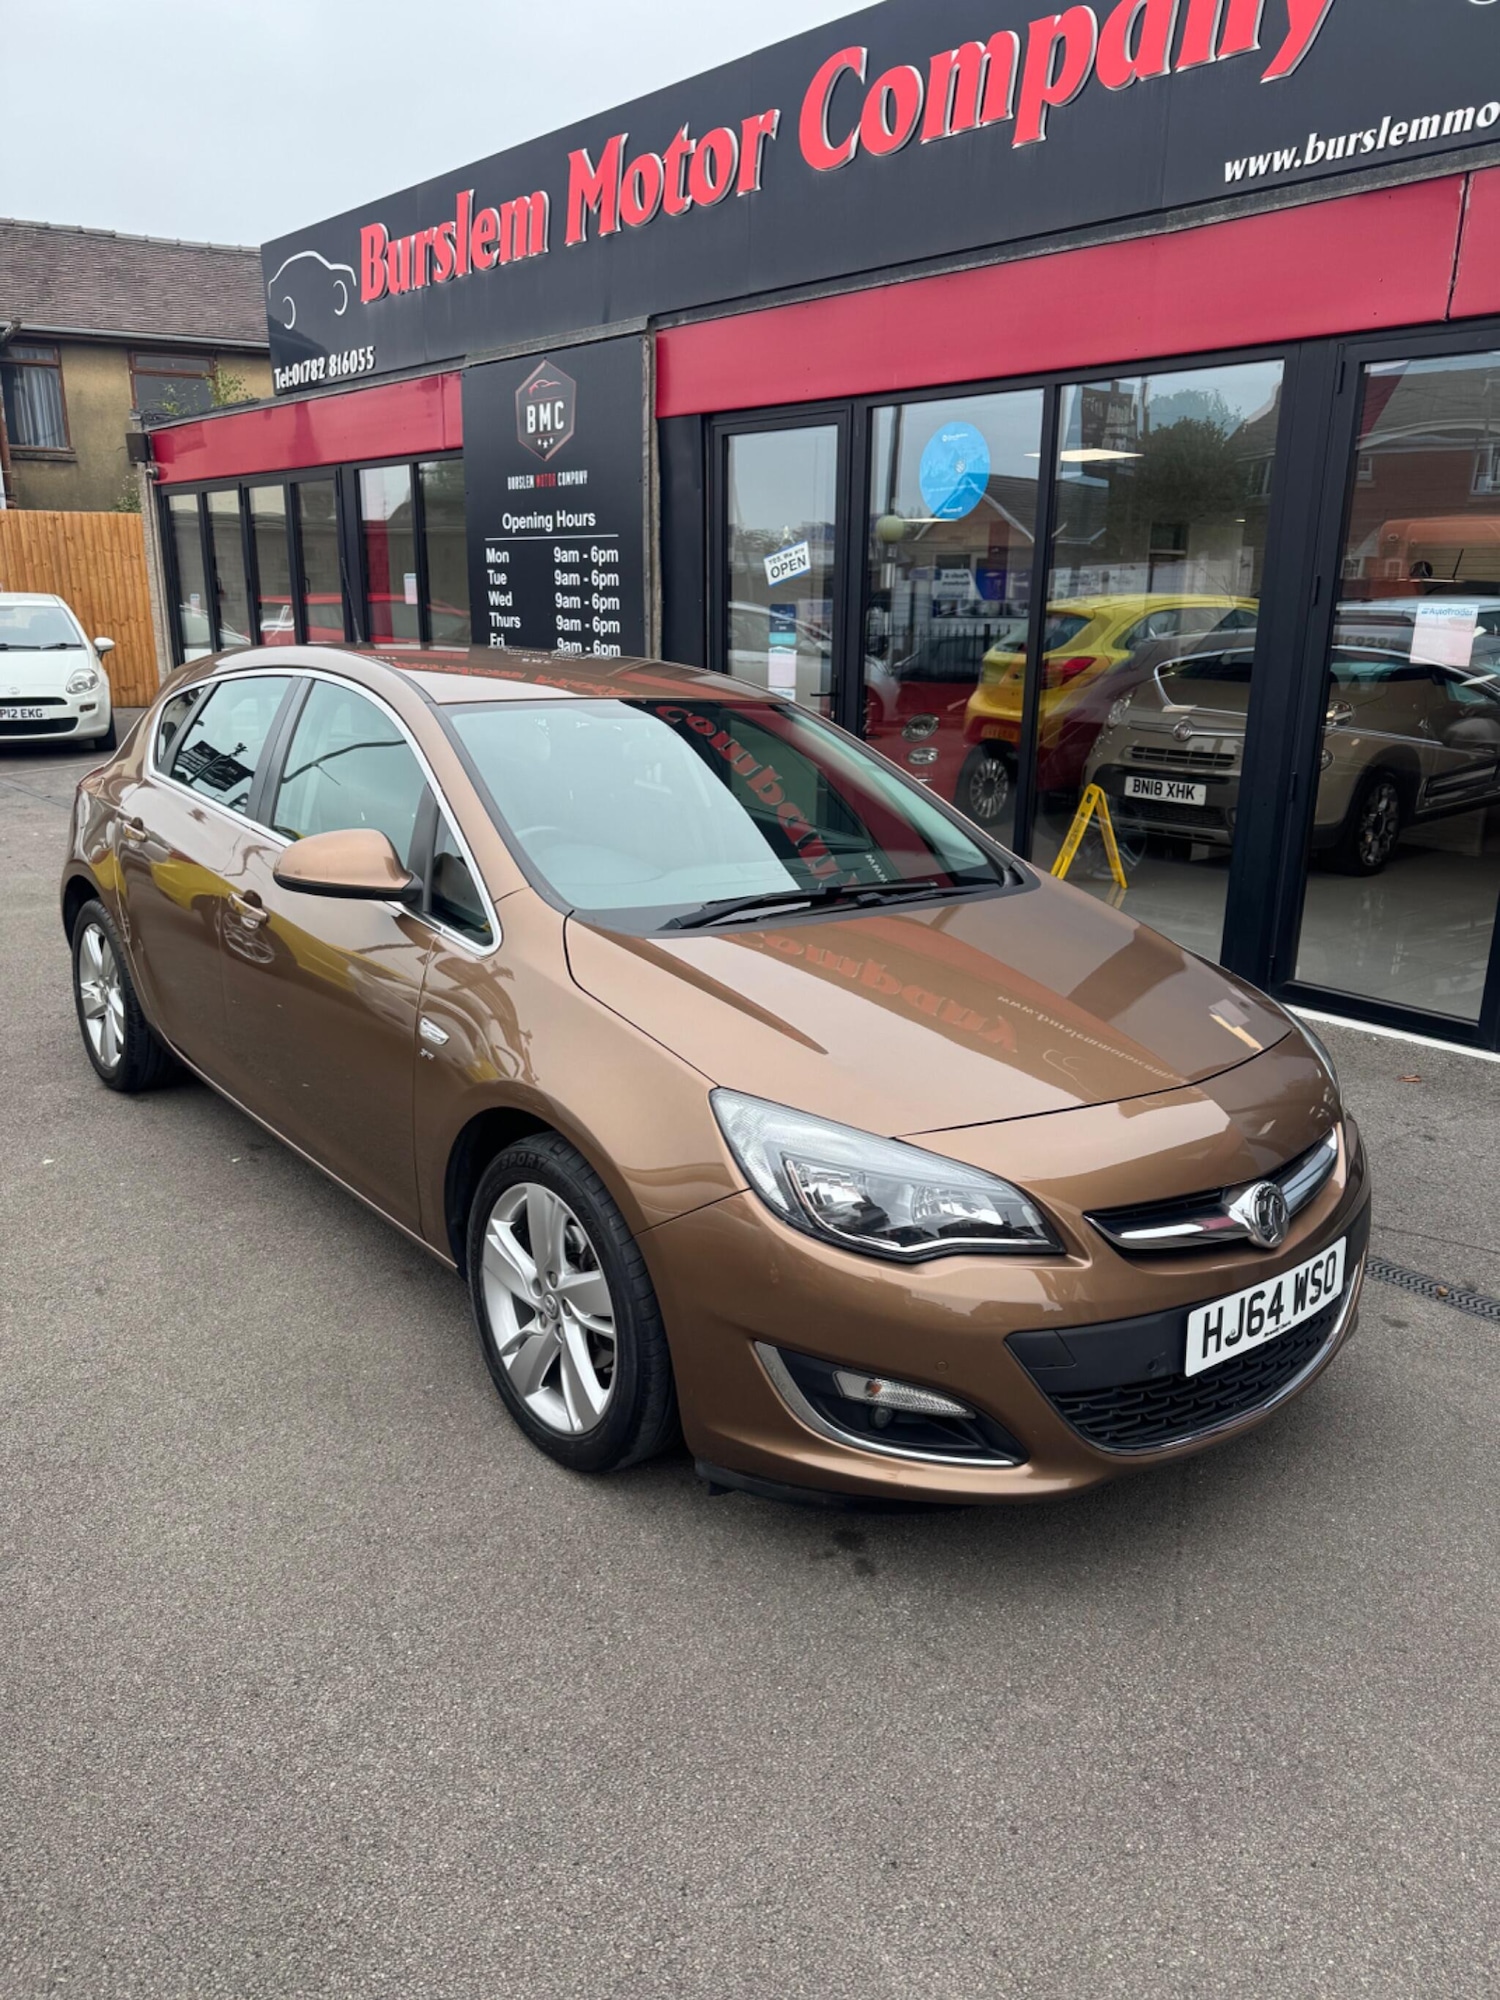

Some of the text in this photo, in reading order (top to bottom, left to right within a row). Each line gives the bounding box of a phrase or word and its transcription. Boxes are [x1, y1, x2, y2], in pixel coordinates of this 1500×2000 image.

[360, 0, 1335, 304] Burslem Motor Company
[1224, 101, 1500, 184] www.burslemmo
[274, 345, 375, 390] Tel:01782 816055
[526, 401, 565, 434] BMC
[557, 470, 588, 487] COMPANY
[502, 510, 596, 533] Opening Hours
[486, 548, 509, 563] Mon
[554, 546, 579, 563] 9am
[590, 545, 619, 566] 6pm
[770, 554, 806, 578] OPEN
[487, 569, 507, 585] Tue
[554, 569, 580, 586] 9am
[591, 569, 620, 590] 6pm
[488, 591, 513, 606] Wed
[555, 592, 581, 608] 9am
[591, 593, 620, 613] 6pm
[489, 612, 521, 628] Thurs
[556, 615, 581, 631] 9am
[592, 616, 620, 637] 6pm
[490, 633, 505, 648] Fri
[557, 637, 582, 653] 9am
[593, 639, 621, 657] 6pm
[20, 708, 43, 718] EKG
[1133, 779, 1196, 800] BN18 XHK
[501, 1152, 549, 1170] SPORT
[1202, 1250, 1337, 1360] HJ64 WSO
